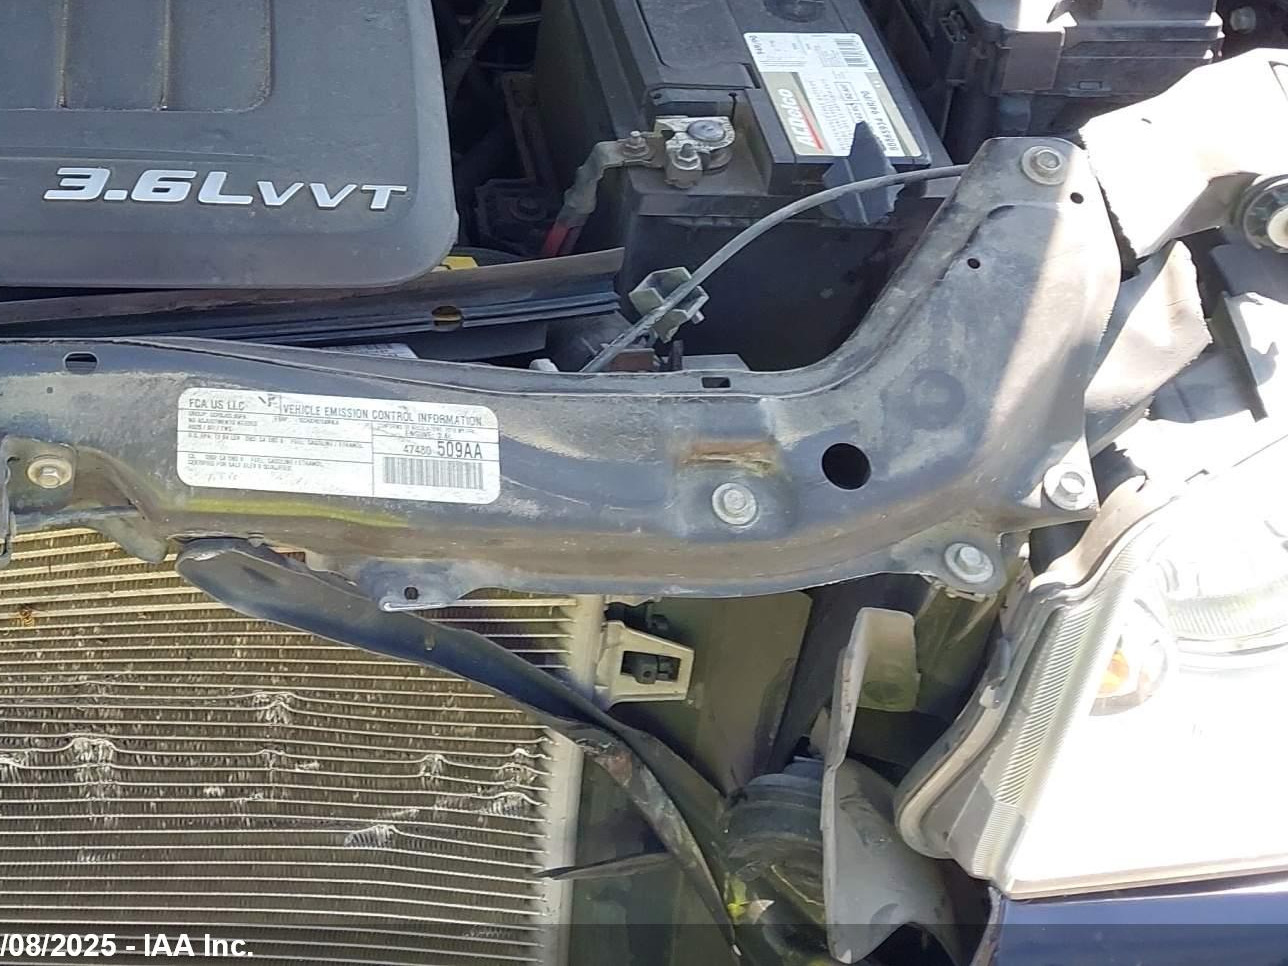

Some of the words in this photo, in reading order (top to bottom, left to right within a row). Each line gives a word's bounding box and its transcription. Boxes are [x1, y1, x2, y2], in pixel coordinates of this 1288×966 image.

[43, 166, 254, 206] 3.6L
[257, 180, 408, 211] VVT
[189, 398, 208, 409] FCA
[211, 399, 224, 410] US
[227, 400, 245, 411] LLC
[283, 404, 322, 416] VEHICLE
[325, 406, 369, 419] EMISSION
[372, 410, 414, 422] CONTROL
[417, 413, 482, 427] INFORMATION
[436, 440, 483, 459] 509AA
